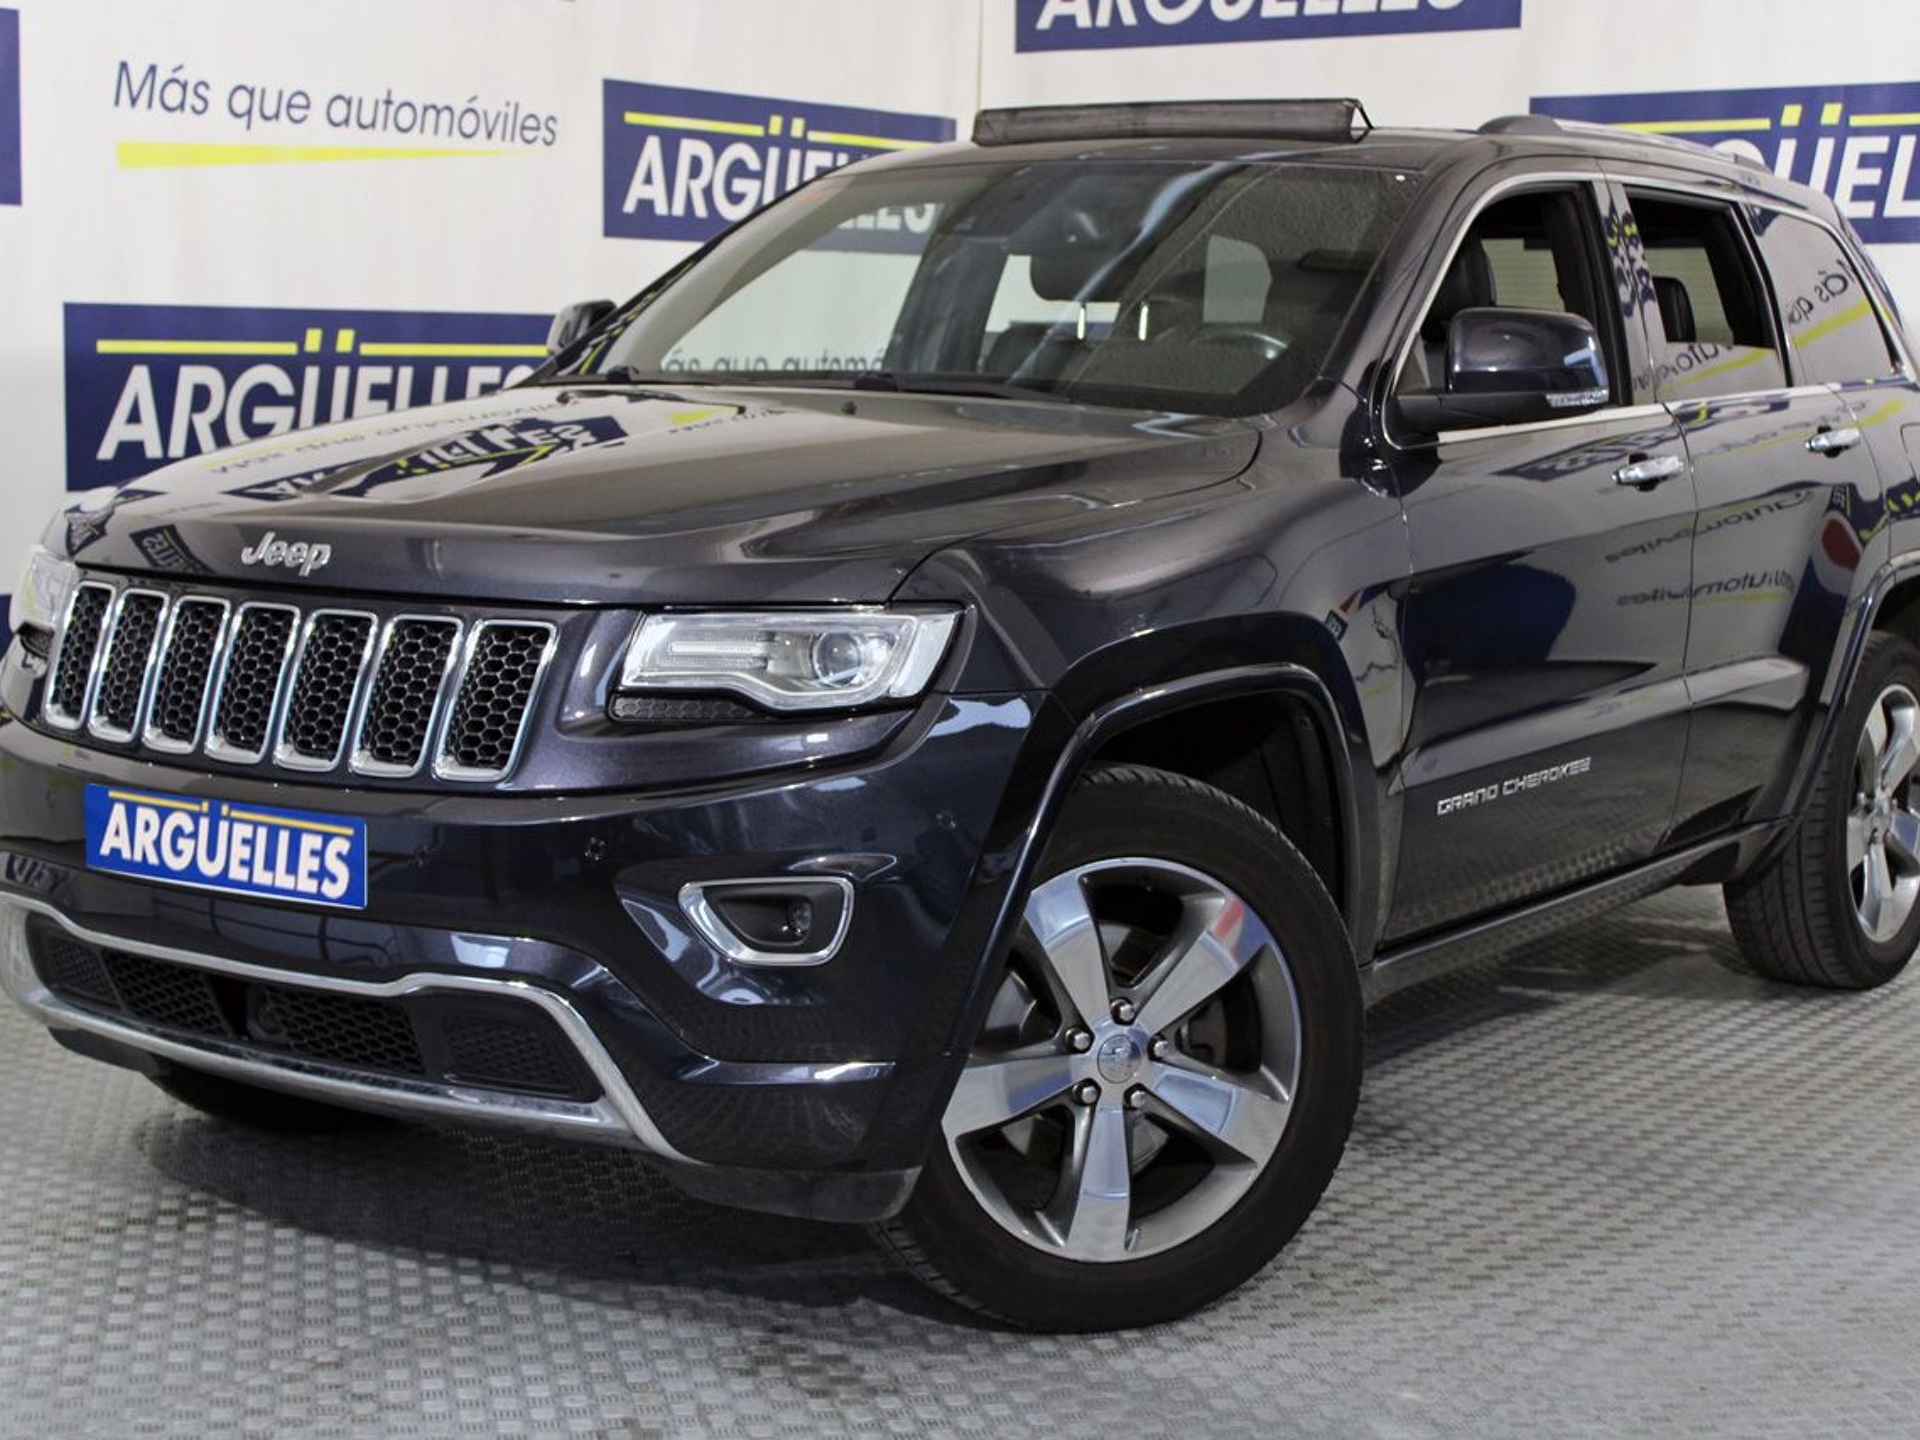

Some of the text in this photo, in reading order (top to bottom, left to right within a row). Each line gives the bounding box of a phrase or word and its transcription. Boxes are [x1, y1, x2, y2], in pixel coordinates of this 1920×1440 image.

[114, 60, 558, 146] Más que automóviles
[241, 531, 331, 577] Jeep
[1502, 757, 1591, 795] CHEROKEE
[99, 801, 352, 899] ARGÜELLES
